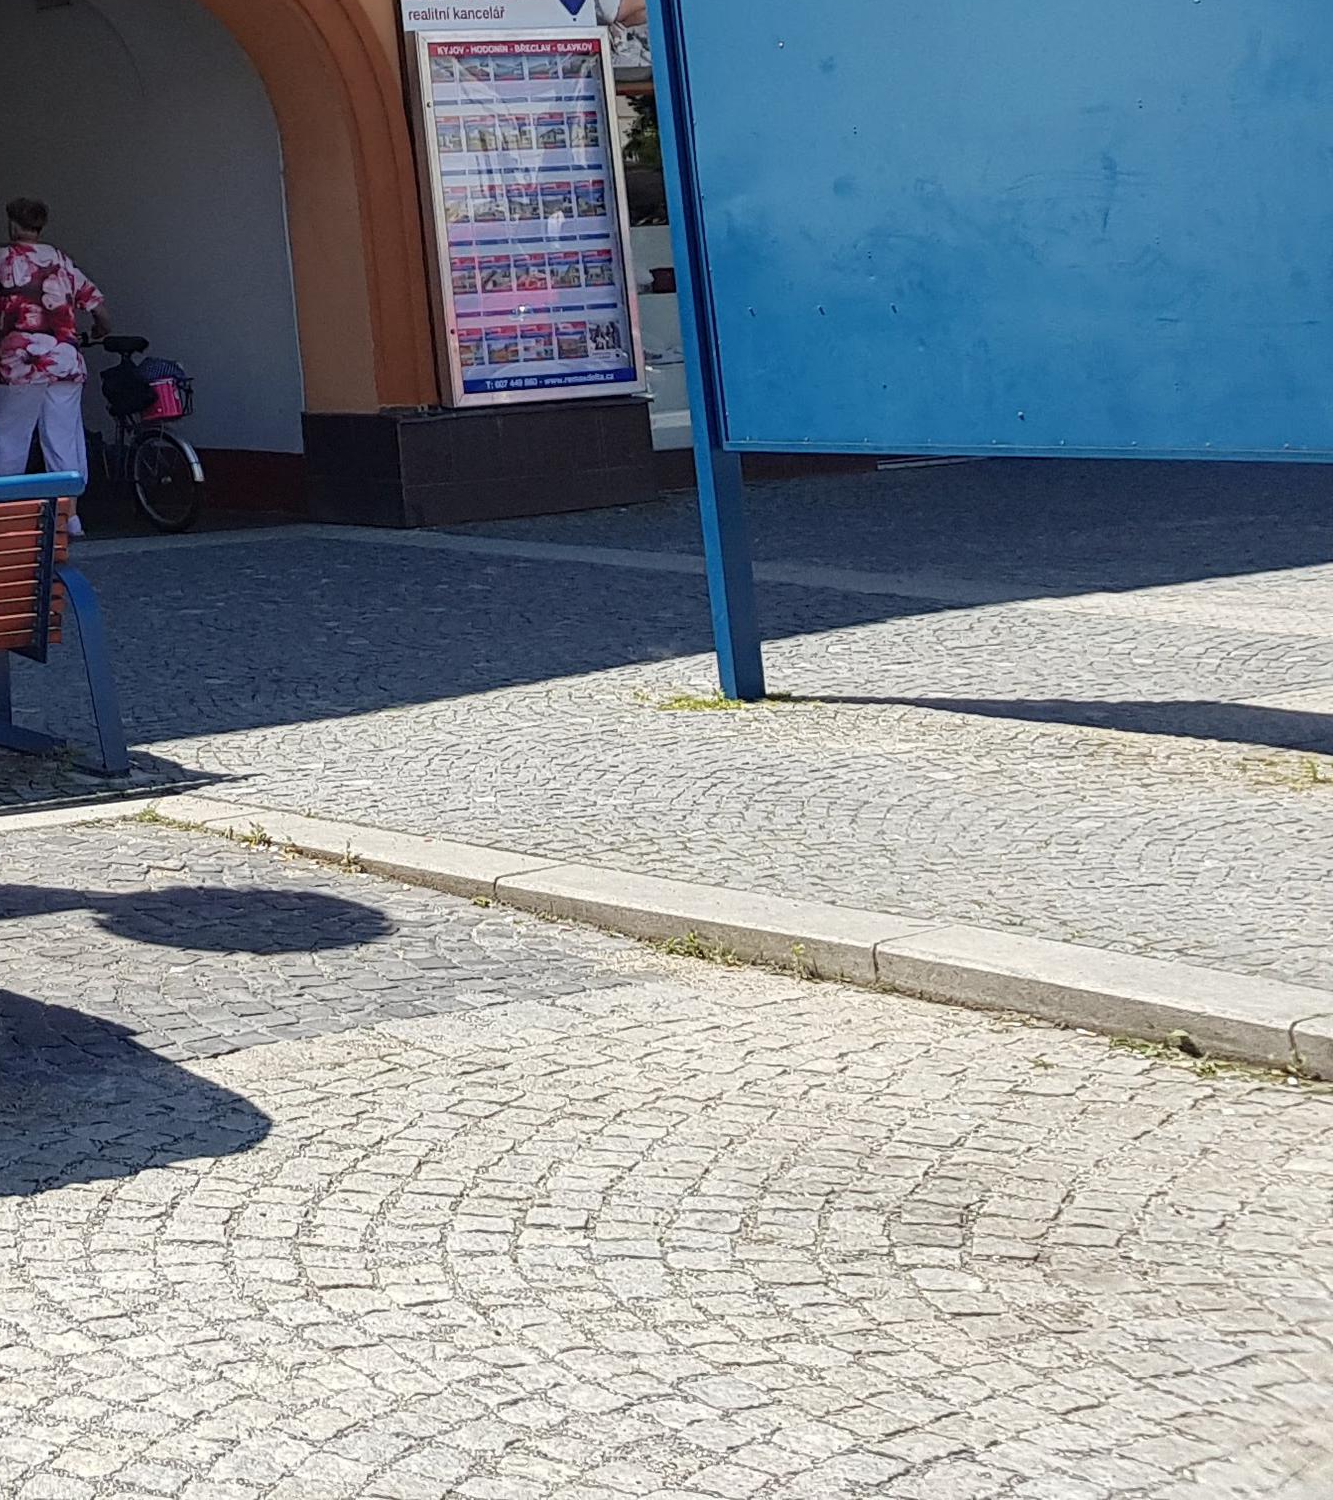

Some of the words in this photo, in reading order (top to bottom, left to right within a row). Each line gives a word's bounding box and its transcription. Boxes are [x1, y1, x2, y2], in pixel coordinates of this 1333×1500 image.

[408, 6, 450, 21] realitní
[453, 5, 506, 21] kancelář
[437, 46, 465, 56] KYJOV
